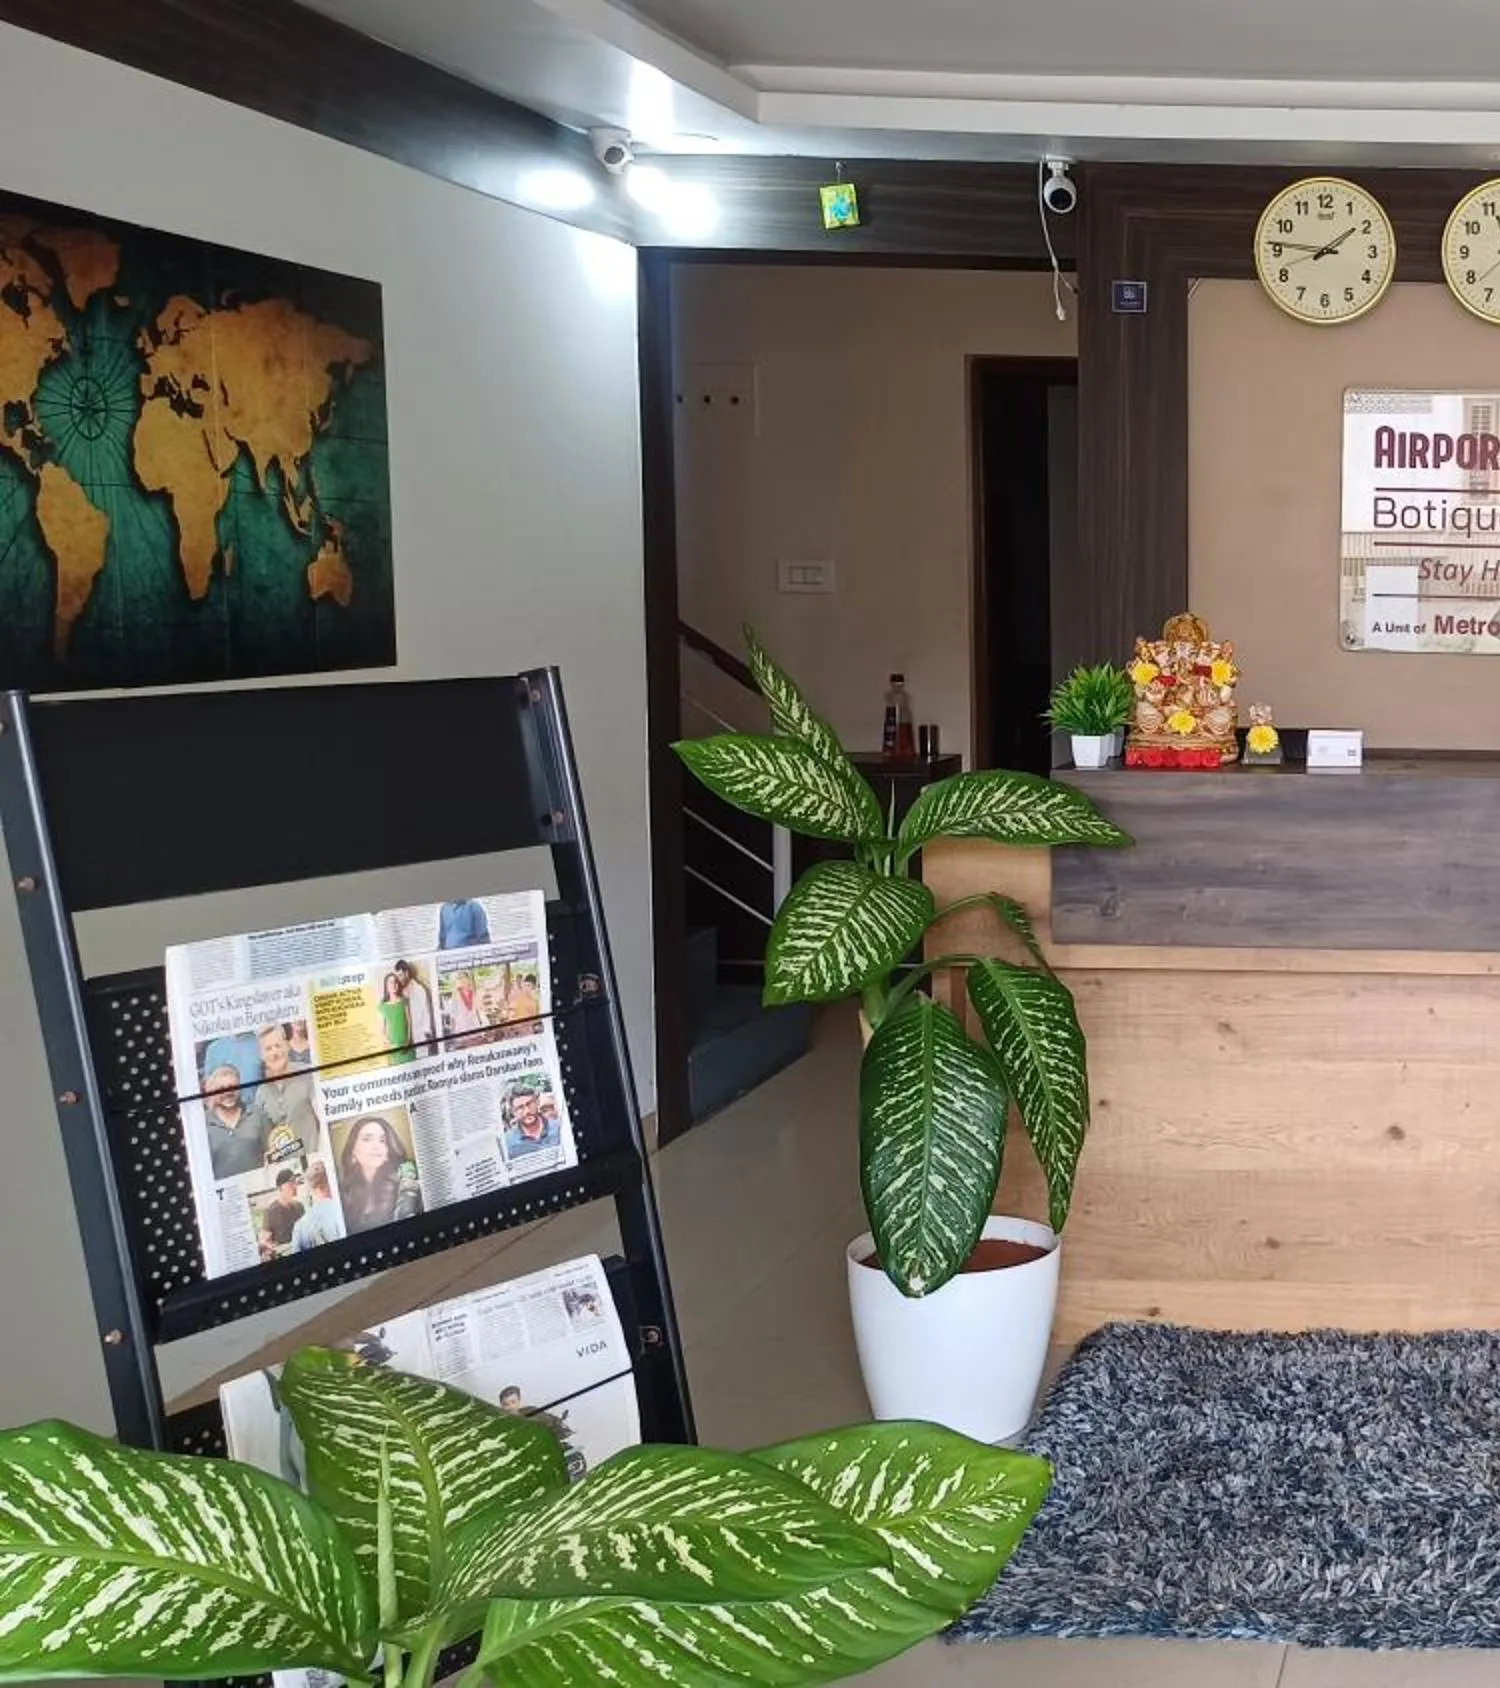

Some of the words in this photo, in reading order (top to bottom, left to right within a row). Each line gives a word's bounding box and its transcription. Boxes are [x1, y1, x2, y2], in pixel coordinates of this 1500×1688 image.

[1296, 201, 1309, 215] 11
[1318, 194, 1333, 209] 12
[1346, 202, 1353, 215] 1
[1482, 202, 1495, 216] 11
[1276, 219, 1293, 233] 10
[1362, 219, 1371, 234] 2
[1465, 221, 1480, 235] 10
[1273, 243, 1283, 257] 9
[1368, 245, 1377, 259] 3
[1459, 245, 1469, 259] 9
[1279, 268, 1289, 282] 8
[1361, 269, 1371, 283] 4
[1466, 270, 1476, 284] 8
[1296, 287, 1306, 300] 7
[1320, 293, 1330, 308] 6
[1344, 287, 1354, 301] 5
[1484, 288, 1494, 302] 7
[1418, 557, 1473, 586] Stay
[1372, 621, 1382, 634] A
[1385, 621, 1410, 635] Unit
[1414, 622, 1427, 635] of
[1434, 616, 1500, 637] Metro
[321, 1085, 349, 1100] Your
[324, 1097, 363, 1117] family
[576, 1339, 608, 1358] VIDA
